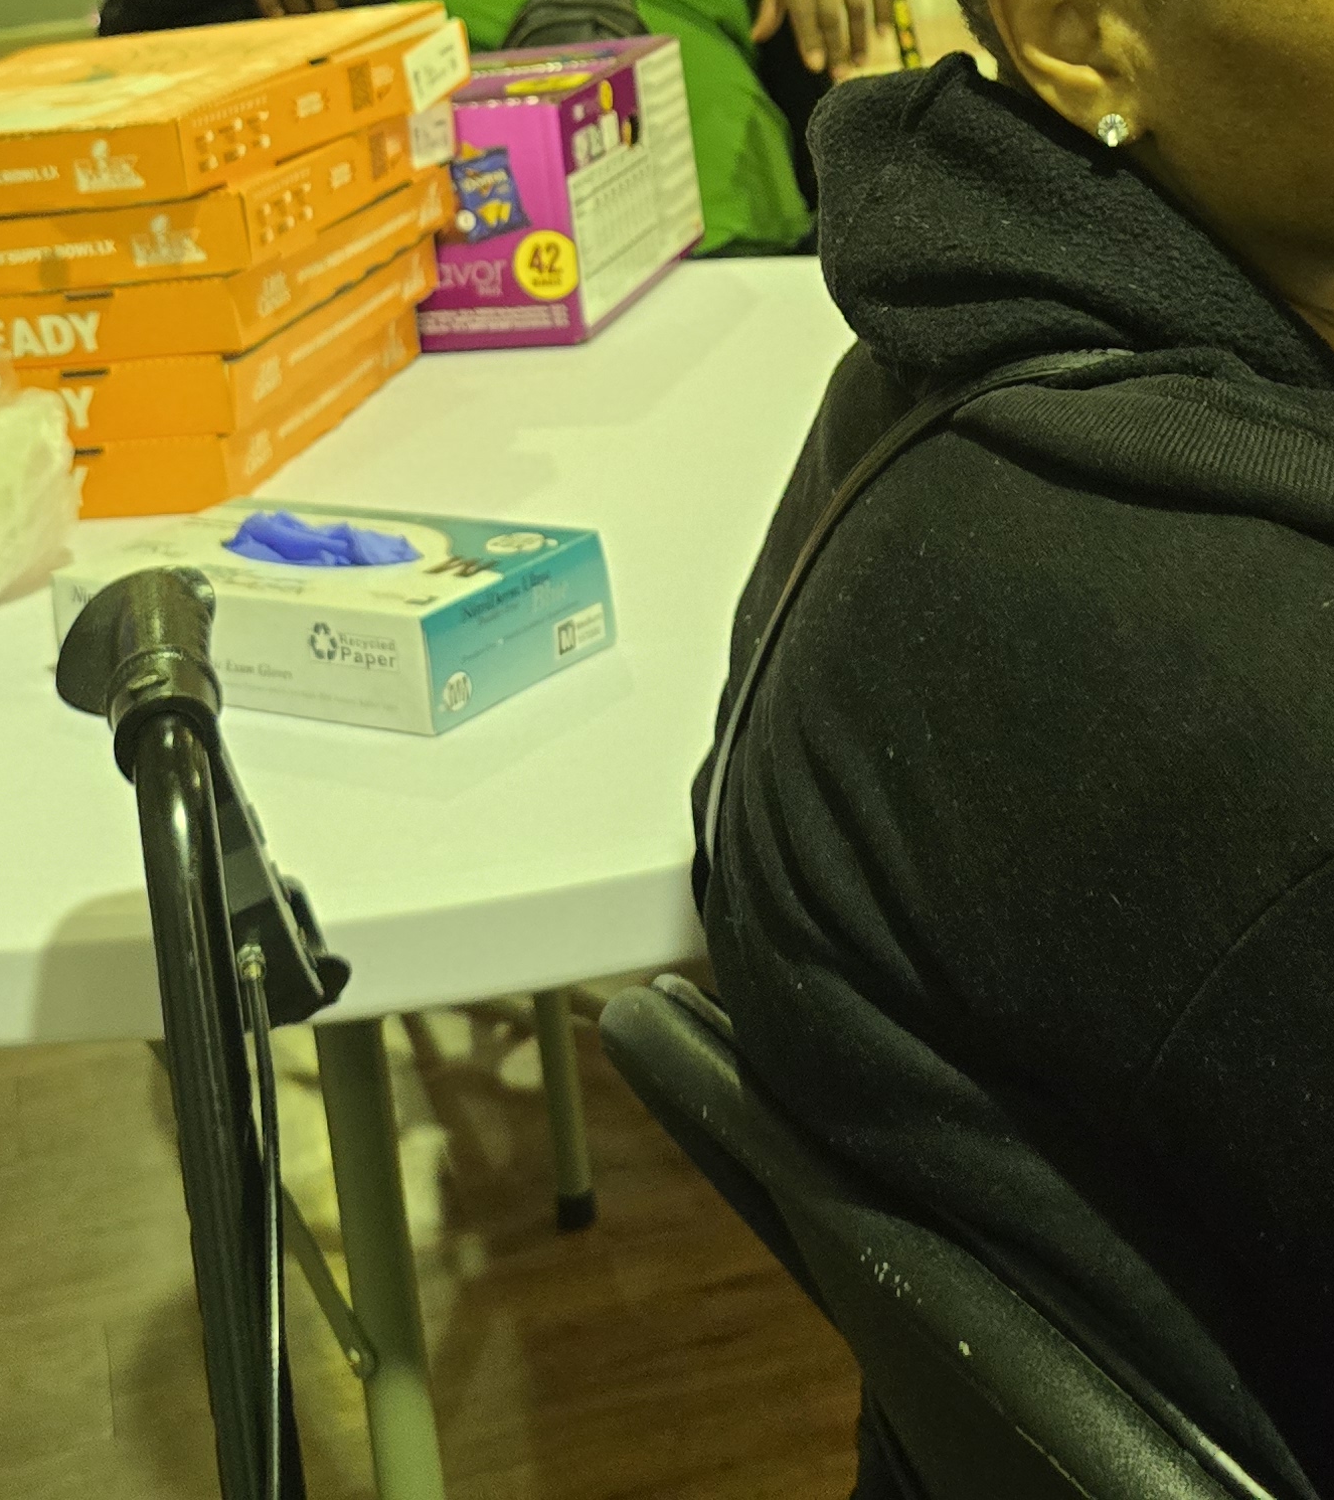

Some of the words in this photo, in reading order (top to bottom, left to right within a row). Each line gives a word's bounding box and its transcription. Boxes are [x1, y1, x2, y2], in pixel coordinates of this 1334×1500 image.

[530, 242, 563, 274] 42
[439, 259, 507, 289] avor
[338, 632, 396, 651] Recycled
[340, 647, 397, 669] Paper
